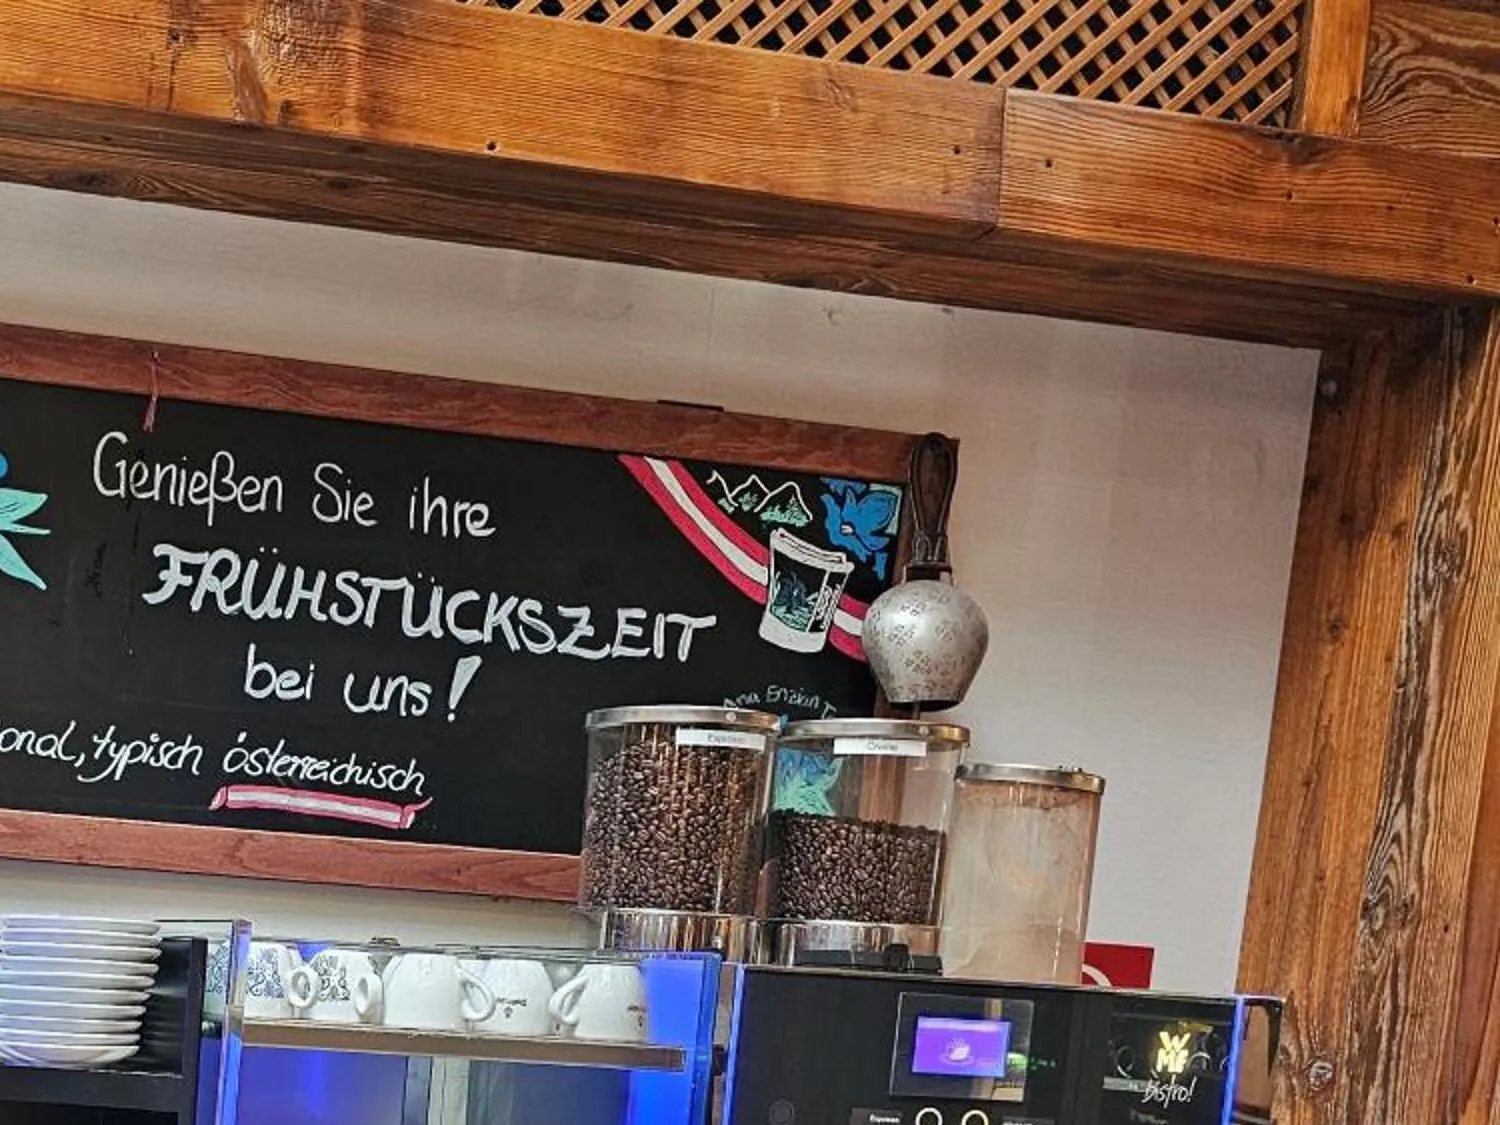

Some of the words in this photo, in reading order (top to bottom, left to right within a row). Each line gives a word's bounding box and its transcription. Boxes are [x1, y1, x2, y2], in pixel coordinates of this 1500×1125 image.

[93, 431, 284, 527] Genießen
[312, 462, 378, 526] Sie
[409, 475, 497, 538] ihre
[142, 543, 717, 663] FRÜHSTÜCKSZEIT
[244, 643, 315, 700] bei
[77, 724, 202, 782] typisch
[1156, 1031, 1191, 1073] WMF
[1141, 1074, 1197, 1109] bistro!
